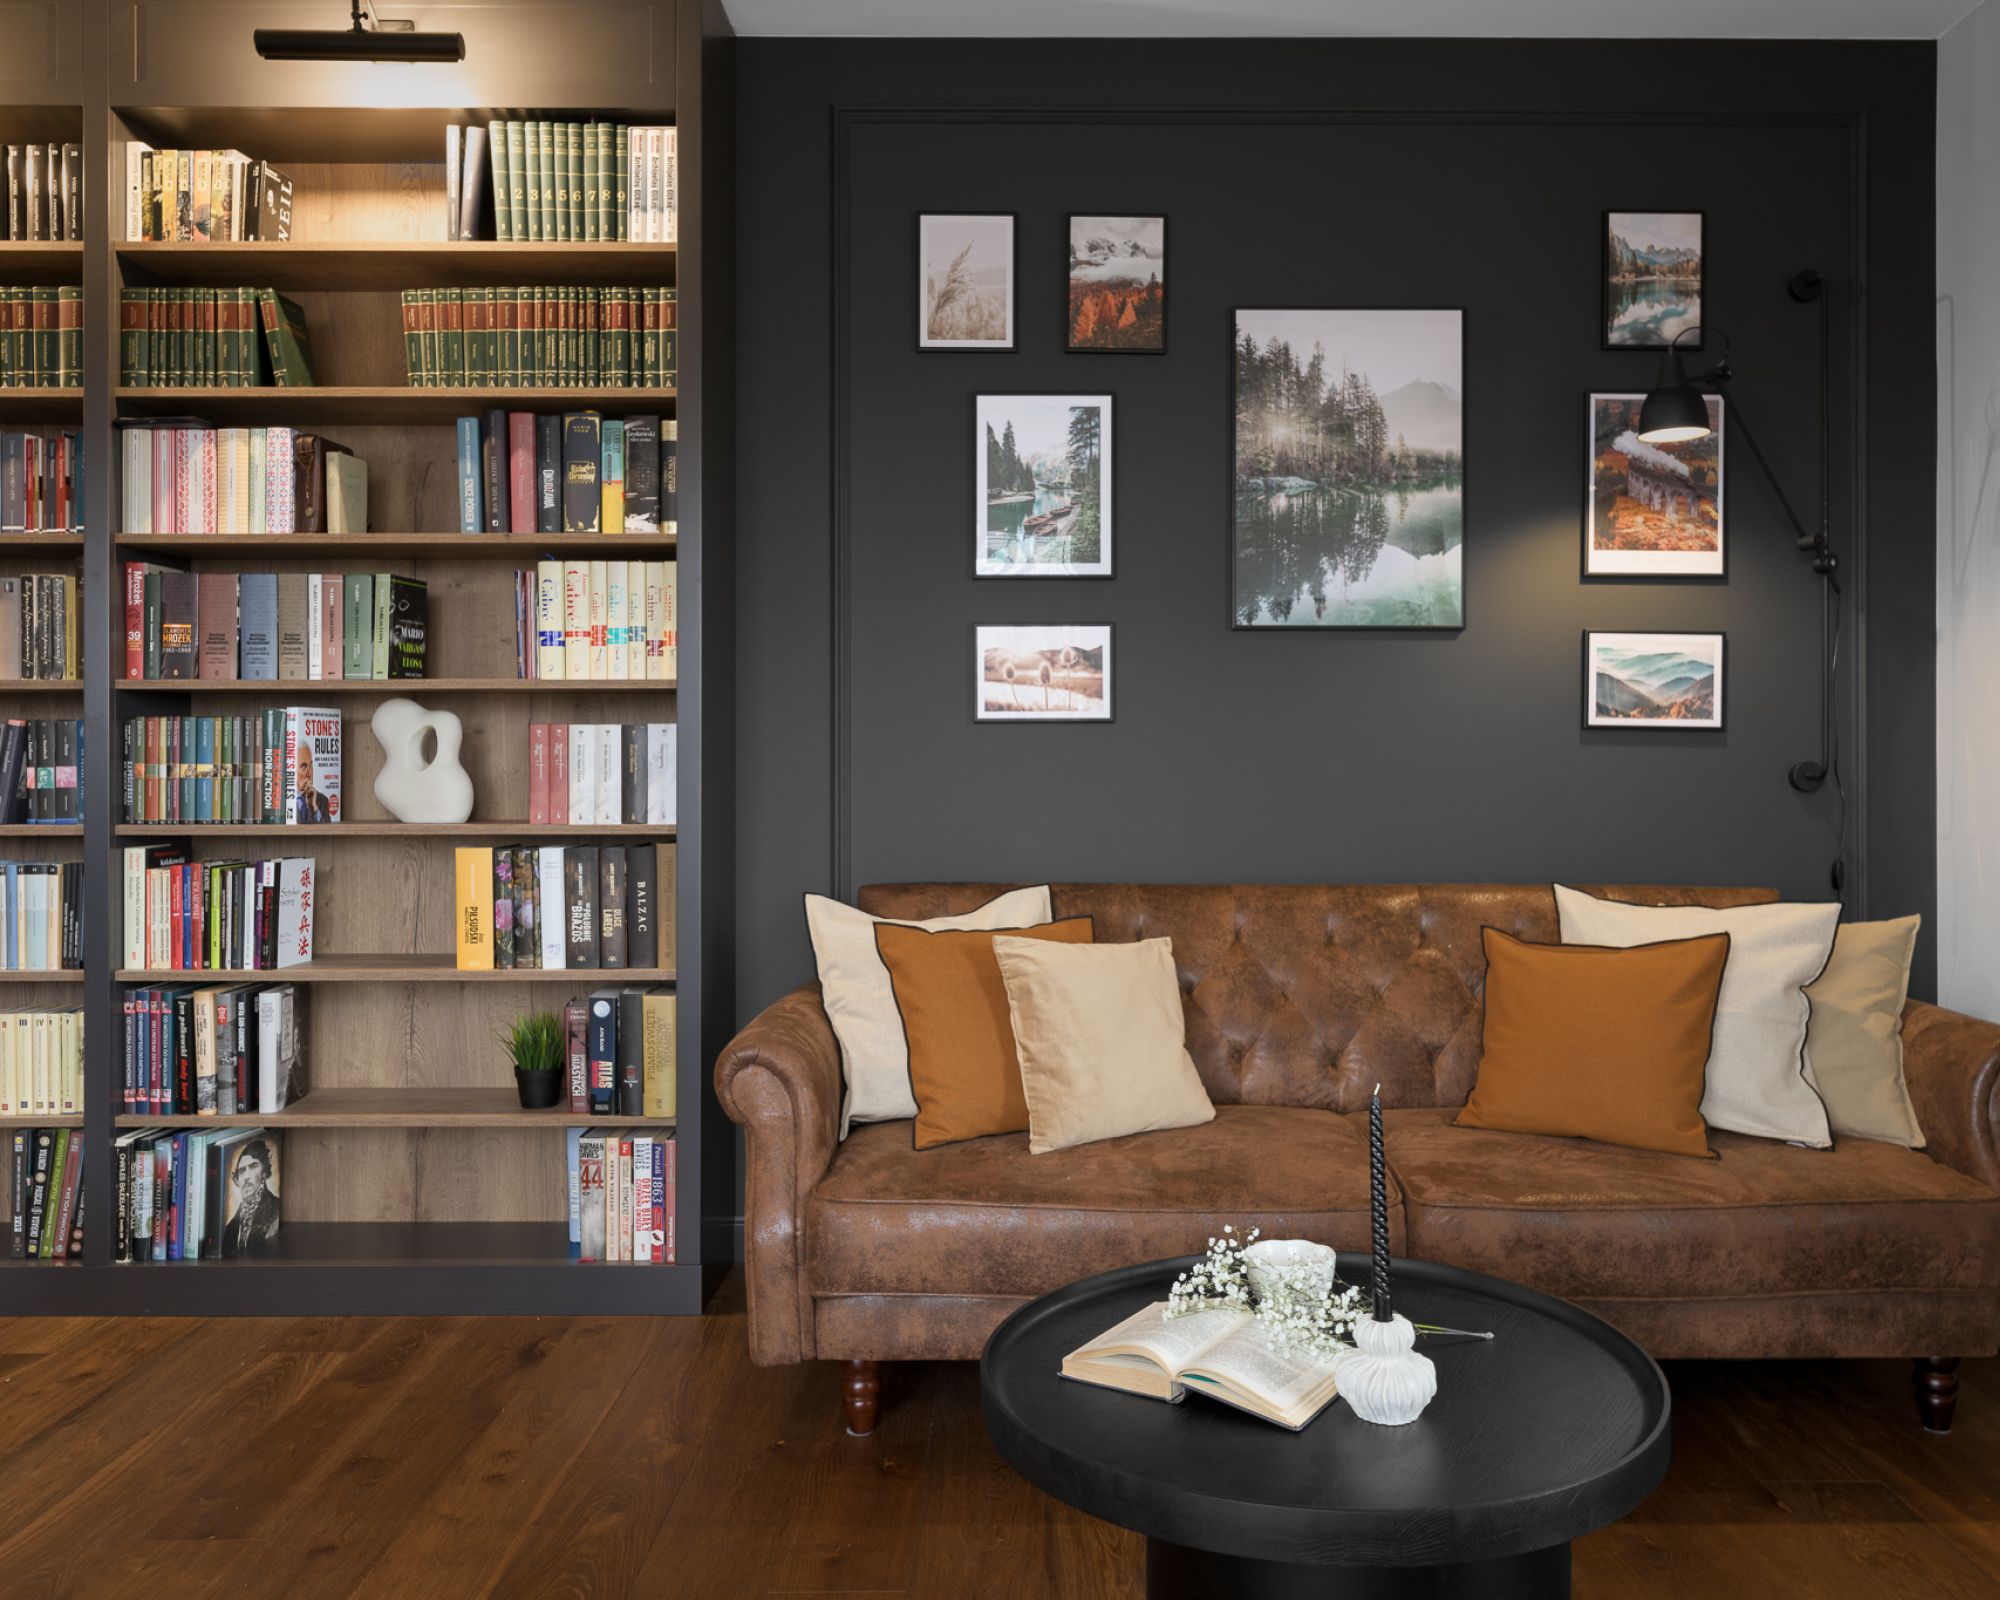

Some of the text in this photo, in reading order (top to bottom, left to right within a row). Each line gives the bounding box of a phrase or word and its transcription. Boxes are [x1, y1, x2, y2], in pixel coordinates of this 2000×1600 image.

[498, 190, 505, 200] 1
[515, 190, 523, 200] 2
[530, 190, 539, 200] 3
[544, 190, 552, 200] 4
[559, 190, 567, 200] 5
[573, 191, 581, 201] 6
[588, 191, 596, 201] 7
[602, 190, 611, 200] 8
[617, 191, 625, 202] 9
[276, 180, 294, 242] WEIL
[133, 570, 144, 606] Mrożek
[128, 631, 141, 640] 39
[401, 626, 424, 640] MARIO
[399, 642, 424, 654] VARGAS
[402, 657, 423, 669] LLOSA
[305, 719, 340, 736] STONE'S
[314, 738, 340, 755] RULES
[286, 731, 296, 799] STONE'S RULES
[264, 748, 273, 809] NON-FICTION
[614, 909, 622, 927] ULICE
[637, 880, 647, 933] BALZAC
[470, 906, 478, 944] PIŁSUDSKI
[571, 905, 582, 943] BRAZOS
[584, 908, 592, 942] POŁUDNIE
[603, 909, 612, 937] LAREDO
[178, 1001, 188, 1056] jan polkowski
[646, 1008, 656, 1080] PISMO ŚWIĘTE
[571, 1054, 581, 1096] MIASTACH
[598, 1060, 613, 1088] ATLAS
[635, 1143, 643, 1169] DAVIES
[50, 1168, 60, 1200] Kuchnia
[652, 1177, 663, 1202] 1863
[58, 1187, 71, 1241] KUCHNIA POLSKA
[641, 1177, 651, 1232] ORZEŁ BIAŁY
[29, 1216, 39, 1237] OKRASA
